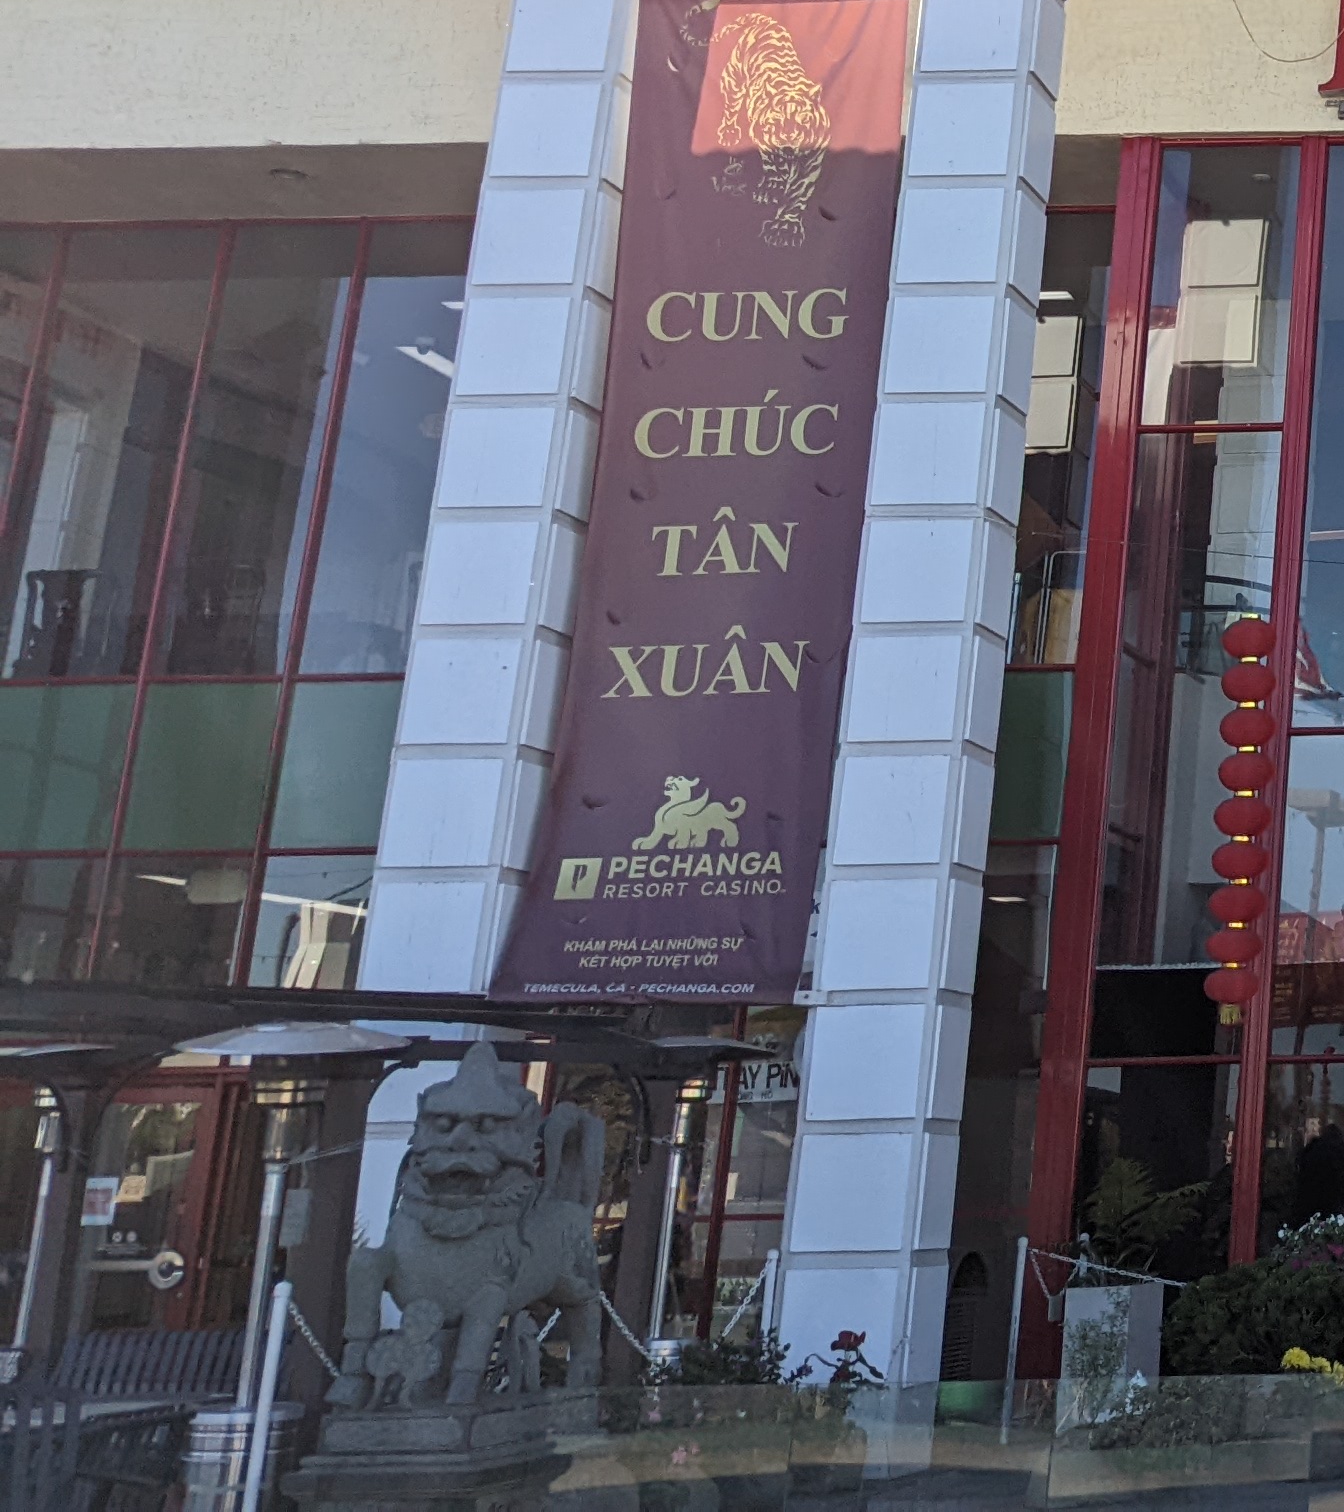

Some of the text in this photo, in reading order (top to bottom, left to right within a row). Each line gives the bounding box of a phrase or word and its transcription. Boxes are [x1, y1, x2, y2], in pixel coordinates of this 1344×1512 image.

[646, 287, 850, 342] CUNG
[633, 388, 841, 459] CHÚC
[651, 506, 800, 577] TÂN
[600, 625, 811, 699] XUÂN
[602, 879, 783, 899] RESORT CASINO
[607, 851, 783, 880] PECHANGA
[523, 983, 601, 994] TEMECULA,
[638, 982, 755, 993] PECHANGA.COM
